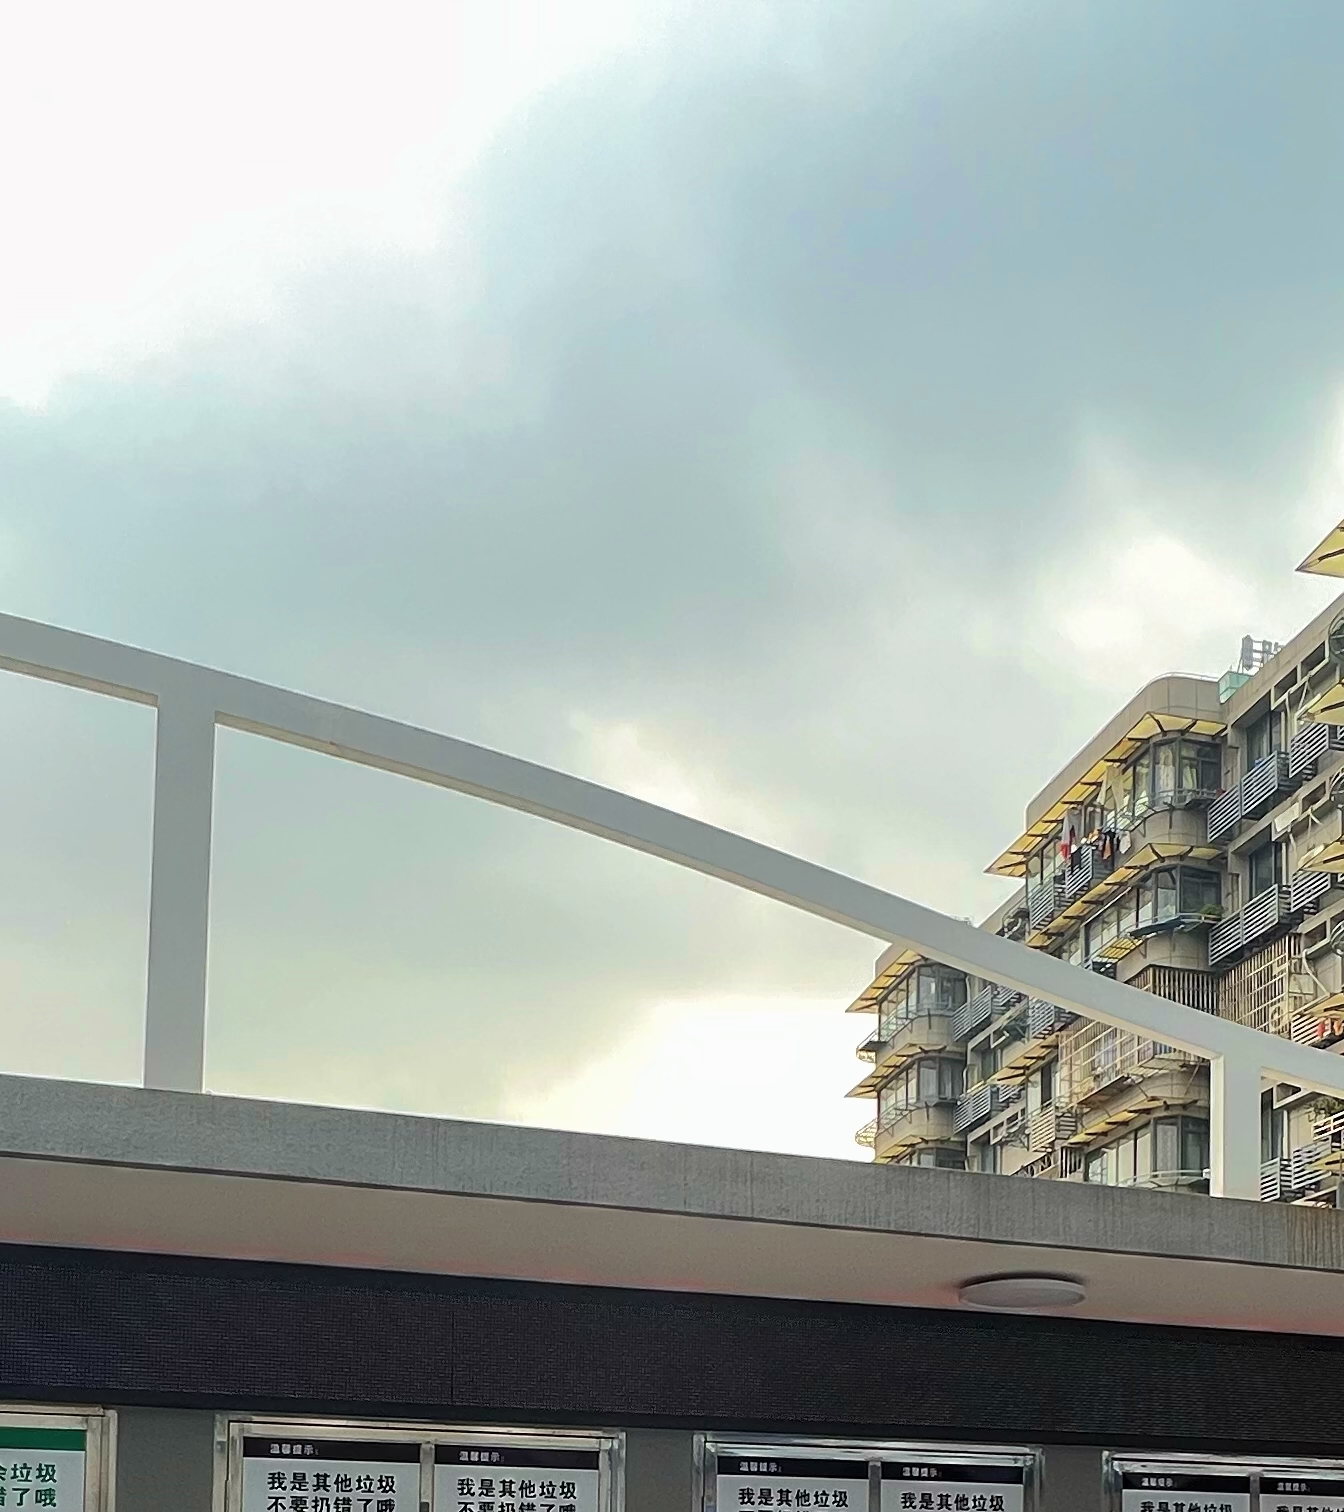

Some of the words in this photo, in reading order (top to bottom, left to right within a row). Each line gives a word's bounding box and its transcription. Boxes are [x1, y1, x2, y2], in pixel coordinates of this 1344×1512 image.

[268, 1472, 396, 1494] 我是其他垃圾
[457, 1478, 576, 1500] 我是其他垃圾
[739, 1488, 848, 1508] 我是其他垃圾
[901, 1492, 1004, 1512] 我是其他垃圾
